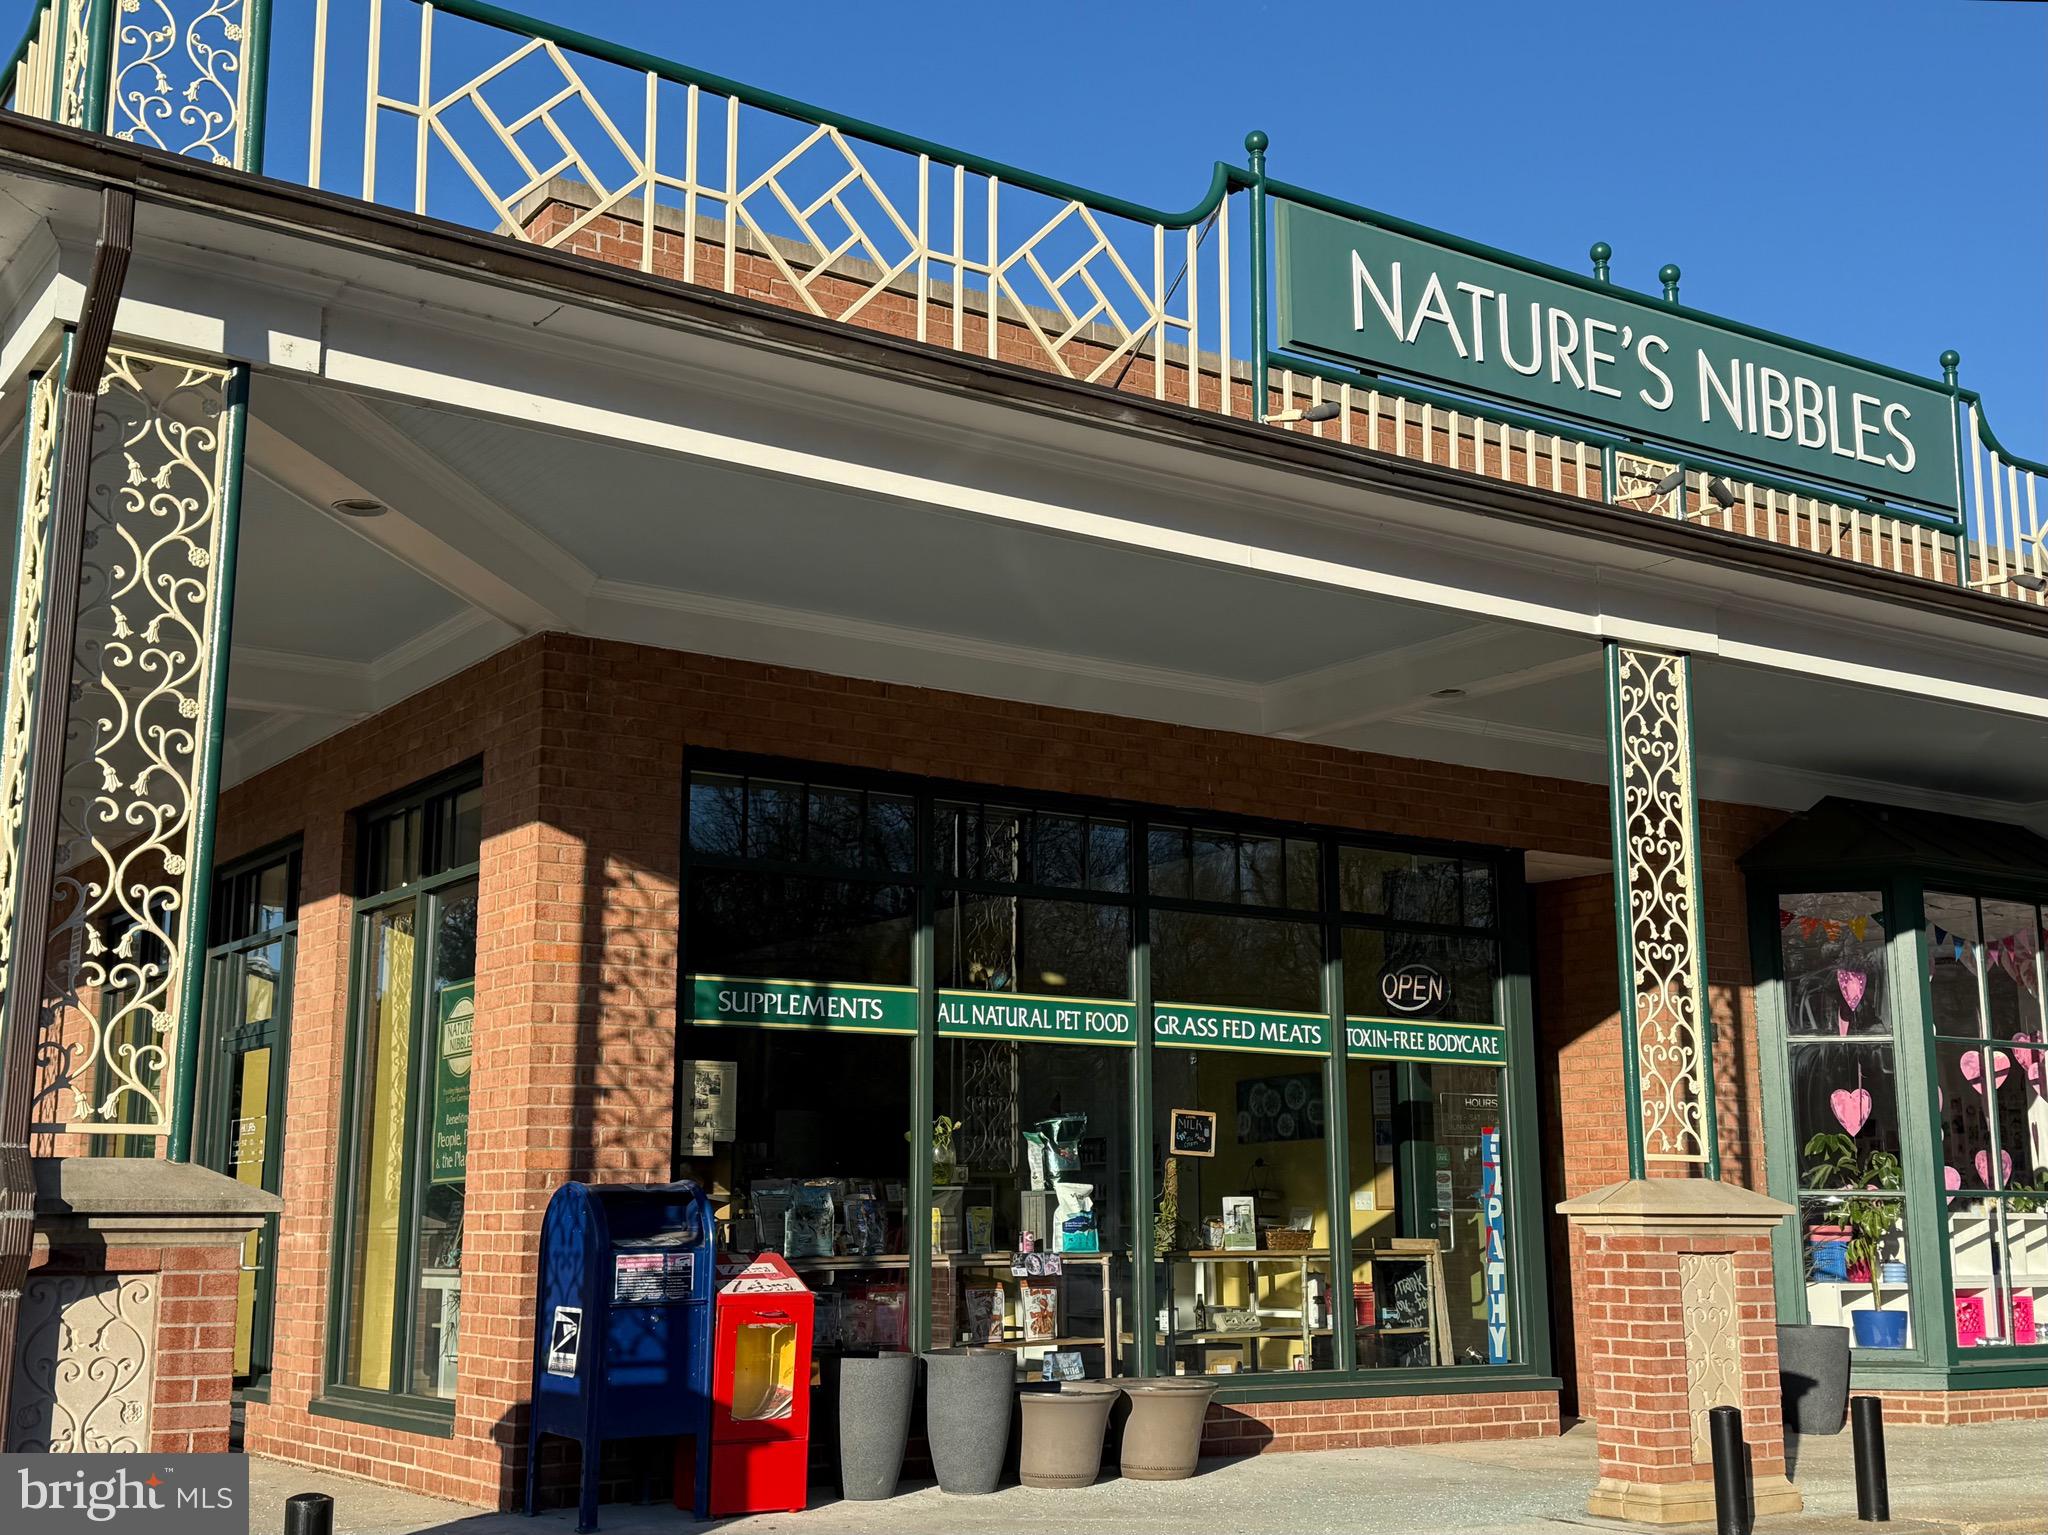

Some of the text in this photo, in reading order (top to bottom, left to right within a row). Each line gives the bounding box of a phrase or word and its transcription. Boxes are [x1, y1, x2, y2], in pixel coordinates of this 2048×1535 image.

[1352, 249, 1916, 474] NATURE'S NIBBLES
[1382, 973, 1442, 1000] OPEN
[718, 990, 883, 1020] SUPPLEMENTS
[937, 1003, 1129, 1033] ALL NATURAL PET FOOD
[1154, 1015, 1322, 1044] GRASS FED MEATS
[1346, 1028, 1499, 1054] TOXIN-FREE BODYCARE
[1465, 1098, 1498, 1108] HOURS
[442, 1152, 453, 1169] the
